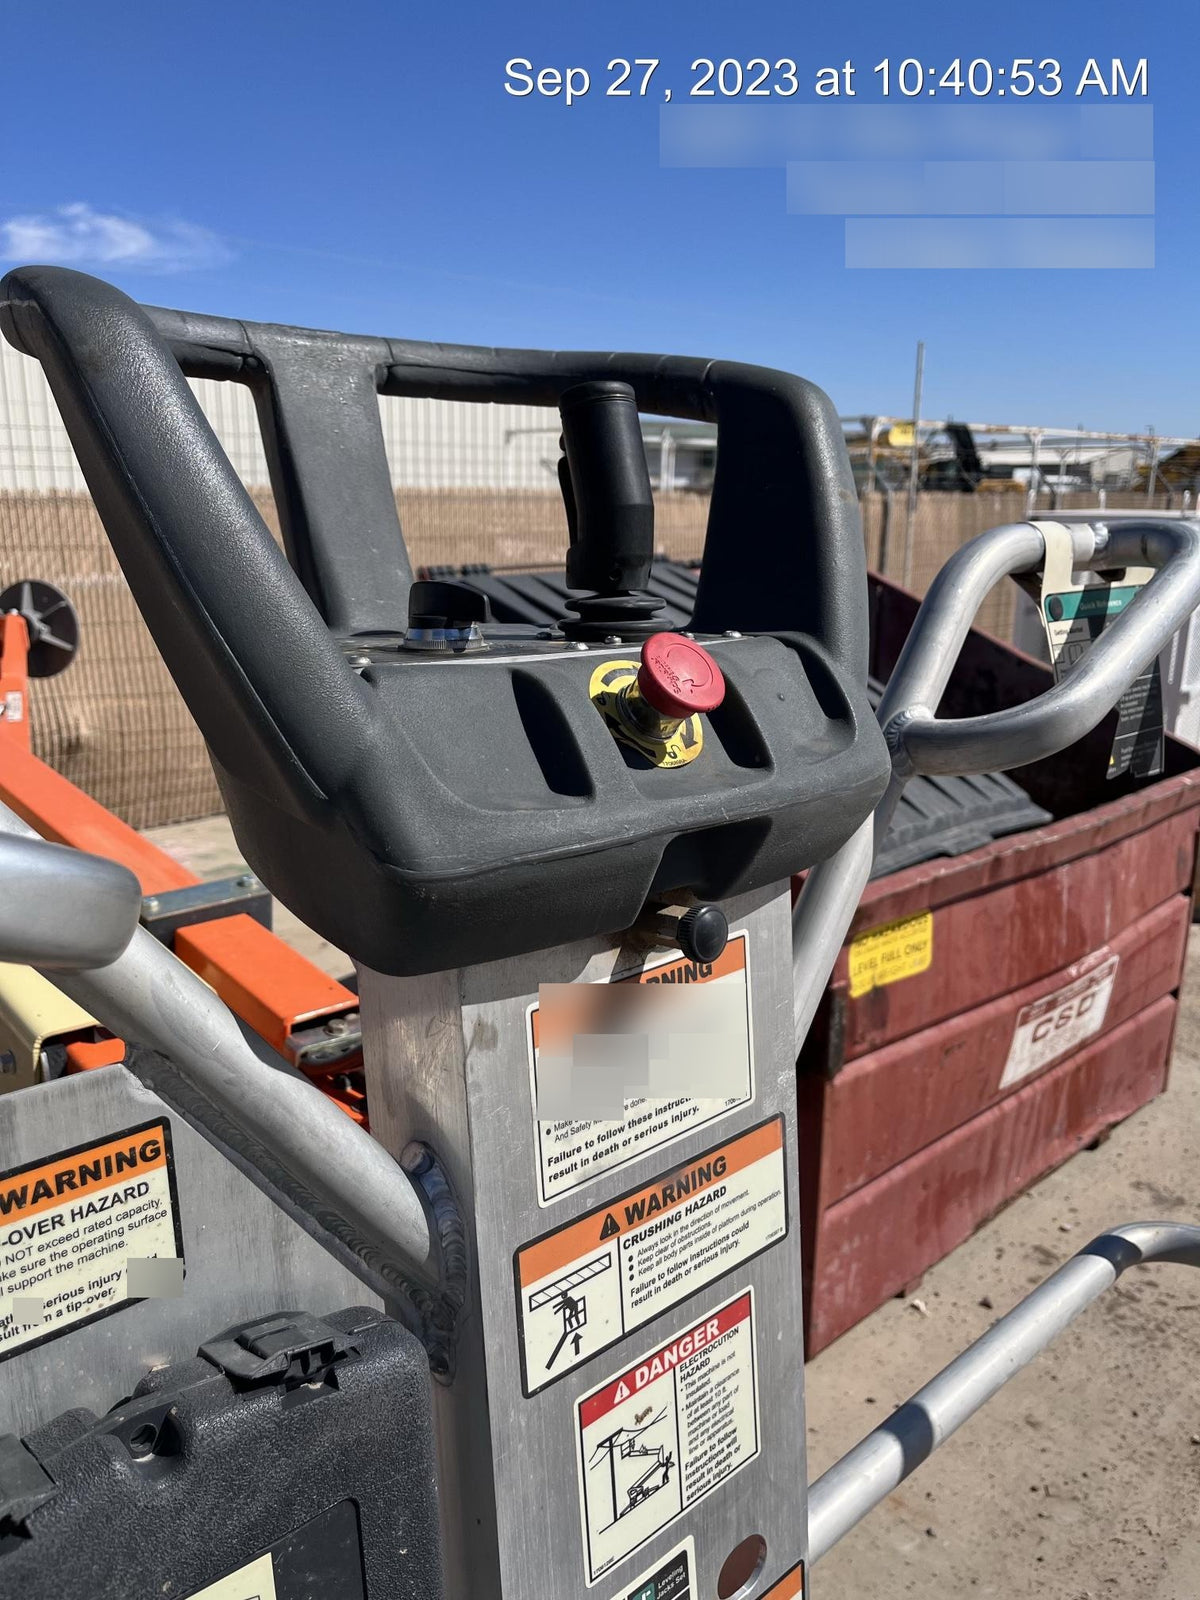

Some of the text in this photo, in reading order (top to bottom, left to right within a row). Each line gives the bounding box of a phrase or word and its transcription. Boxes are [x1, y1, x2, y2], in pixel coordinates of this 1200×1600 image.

[547, 1145, 582, 1168] Failure
[584, 1140, 595, 1150] to
[596, 1123, 626, 1144] follow
[627, 1112, 653, 1130] these
[548, 1105, 700, 1182] result in death or serious injury.
[554, 1120, 593, 1144] And Safety
[0, 1139, 162, 1215] WARNING
[624, 1155, 727, 1226] WARNING
[70, 1181, 150, 1223] HAZARD
[622, 1185, 727, 1250] CRUSHING HAZARD
[4, 1197, 163, 1266] NOT exceed rated capacity.
[20, 1258, 46, 1274] sure
[50, 1249, 68, 1262] the
[71, 1226, 125, 1254] operating
[128, 1209, 168, 1231] surface
[637, 1241, 659, 1258] Always
[660, 1232, 673, 1246] look
[673, 1229, 680, 1238] in
[680, 1223, 689, 1232] the
[690, 1210, 714, 1228] direction
[714, 1204, 720, 1214] of
[638, 1262, 654, 1277] Keep
[663, 1248, 678, 1263] body
[678, 1240, 694, 1255] parts
[694, 1231, 711, 1244] inside
[711, 1224, 718, 1234] of
[718, 1212, 740, 1232] platform
[740, 1203, 757, 1218] during
[757, 1190, 782, 1208] operation.
[638, 1253, 654, 1267] Keep
[654, 1244, 670, 1258] clear
[670, 1238, 676, 1248] of
[7, 1268, 52, 1294] support
[56, 1261, 74, 1274] the
[77, 1240, 128, 1266] machine.
[88, 1269, 122, 1291] injury
[630, 1220, 750, 1298] Failure to follow instructions could
[631, 1238, 740, 1308] result in death or serious injury.
[56, 1286, 116, 1318] a tip-over.
[634, 1317, 720, 1393] DANGER
[680, 1326, 740, 1372] ELECTROCUTION
[680, 1356, 711, 1384] HAZARD
[684, 1379, 696, 1391] This
[697, 1362, 720, 1382] machine
[726, 1350, 736, 1362] not
[685, 1390, 709, 1411] Maintain
[714, 1368, 740, 1390] clearance
[686, 1409, 692, 1419] of
[694, 1406, 700, 1415] at
[700, 1396, 714, 1410] least
[687, 1384, 740, 1428] between any part of
[688, 1400, 730, 1438] machine or load
[688, 1406, 734, 1446] and any electrical
[684, 1426, 738, 1472] Failure to follow
[685, 1434, 738, 1482] instructions will
[685, 1444, 742, 1492] result in death or
[688, 1444, 699, 1454] line
[700, 1438, 706, 1446] or
[686, 1462, 733, 1502] serious injury.
[656, 1572, 686, 1600] Jacks Set
[658, 1564, 684, 1589] Leveling
